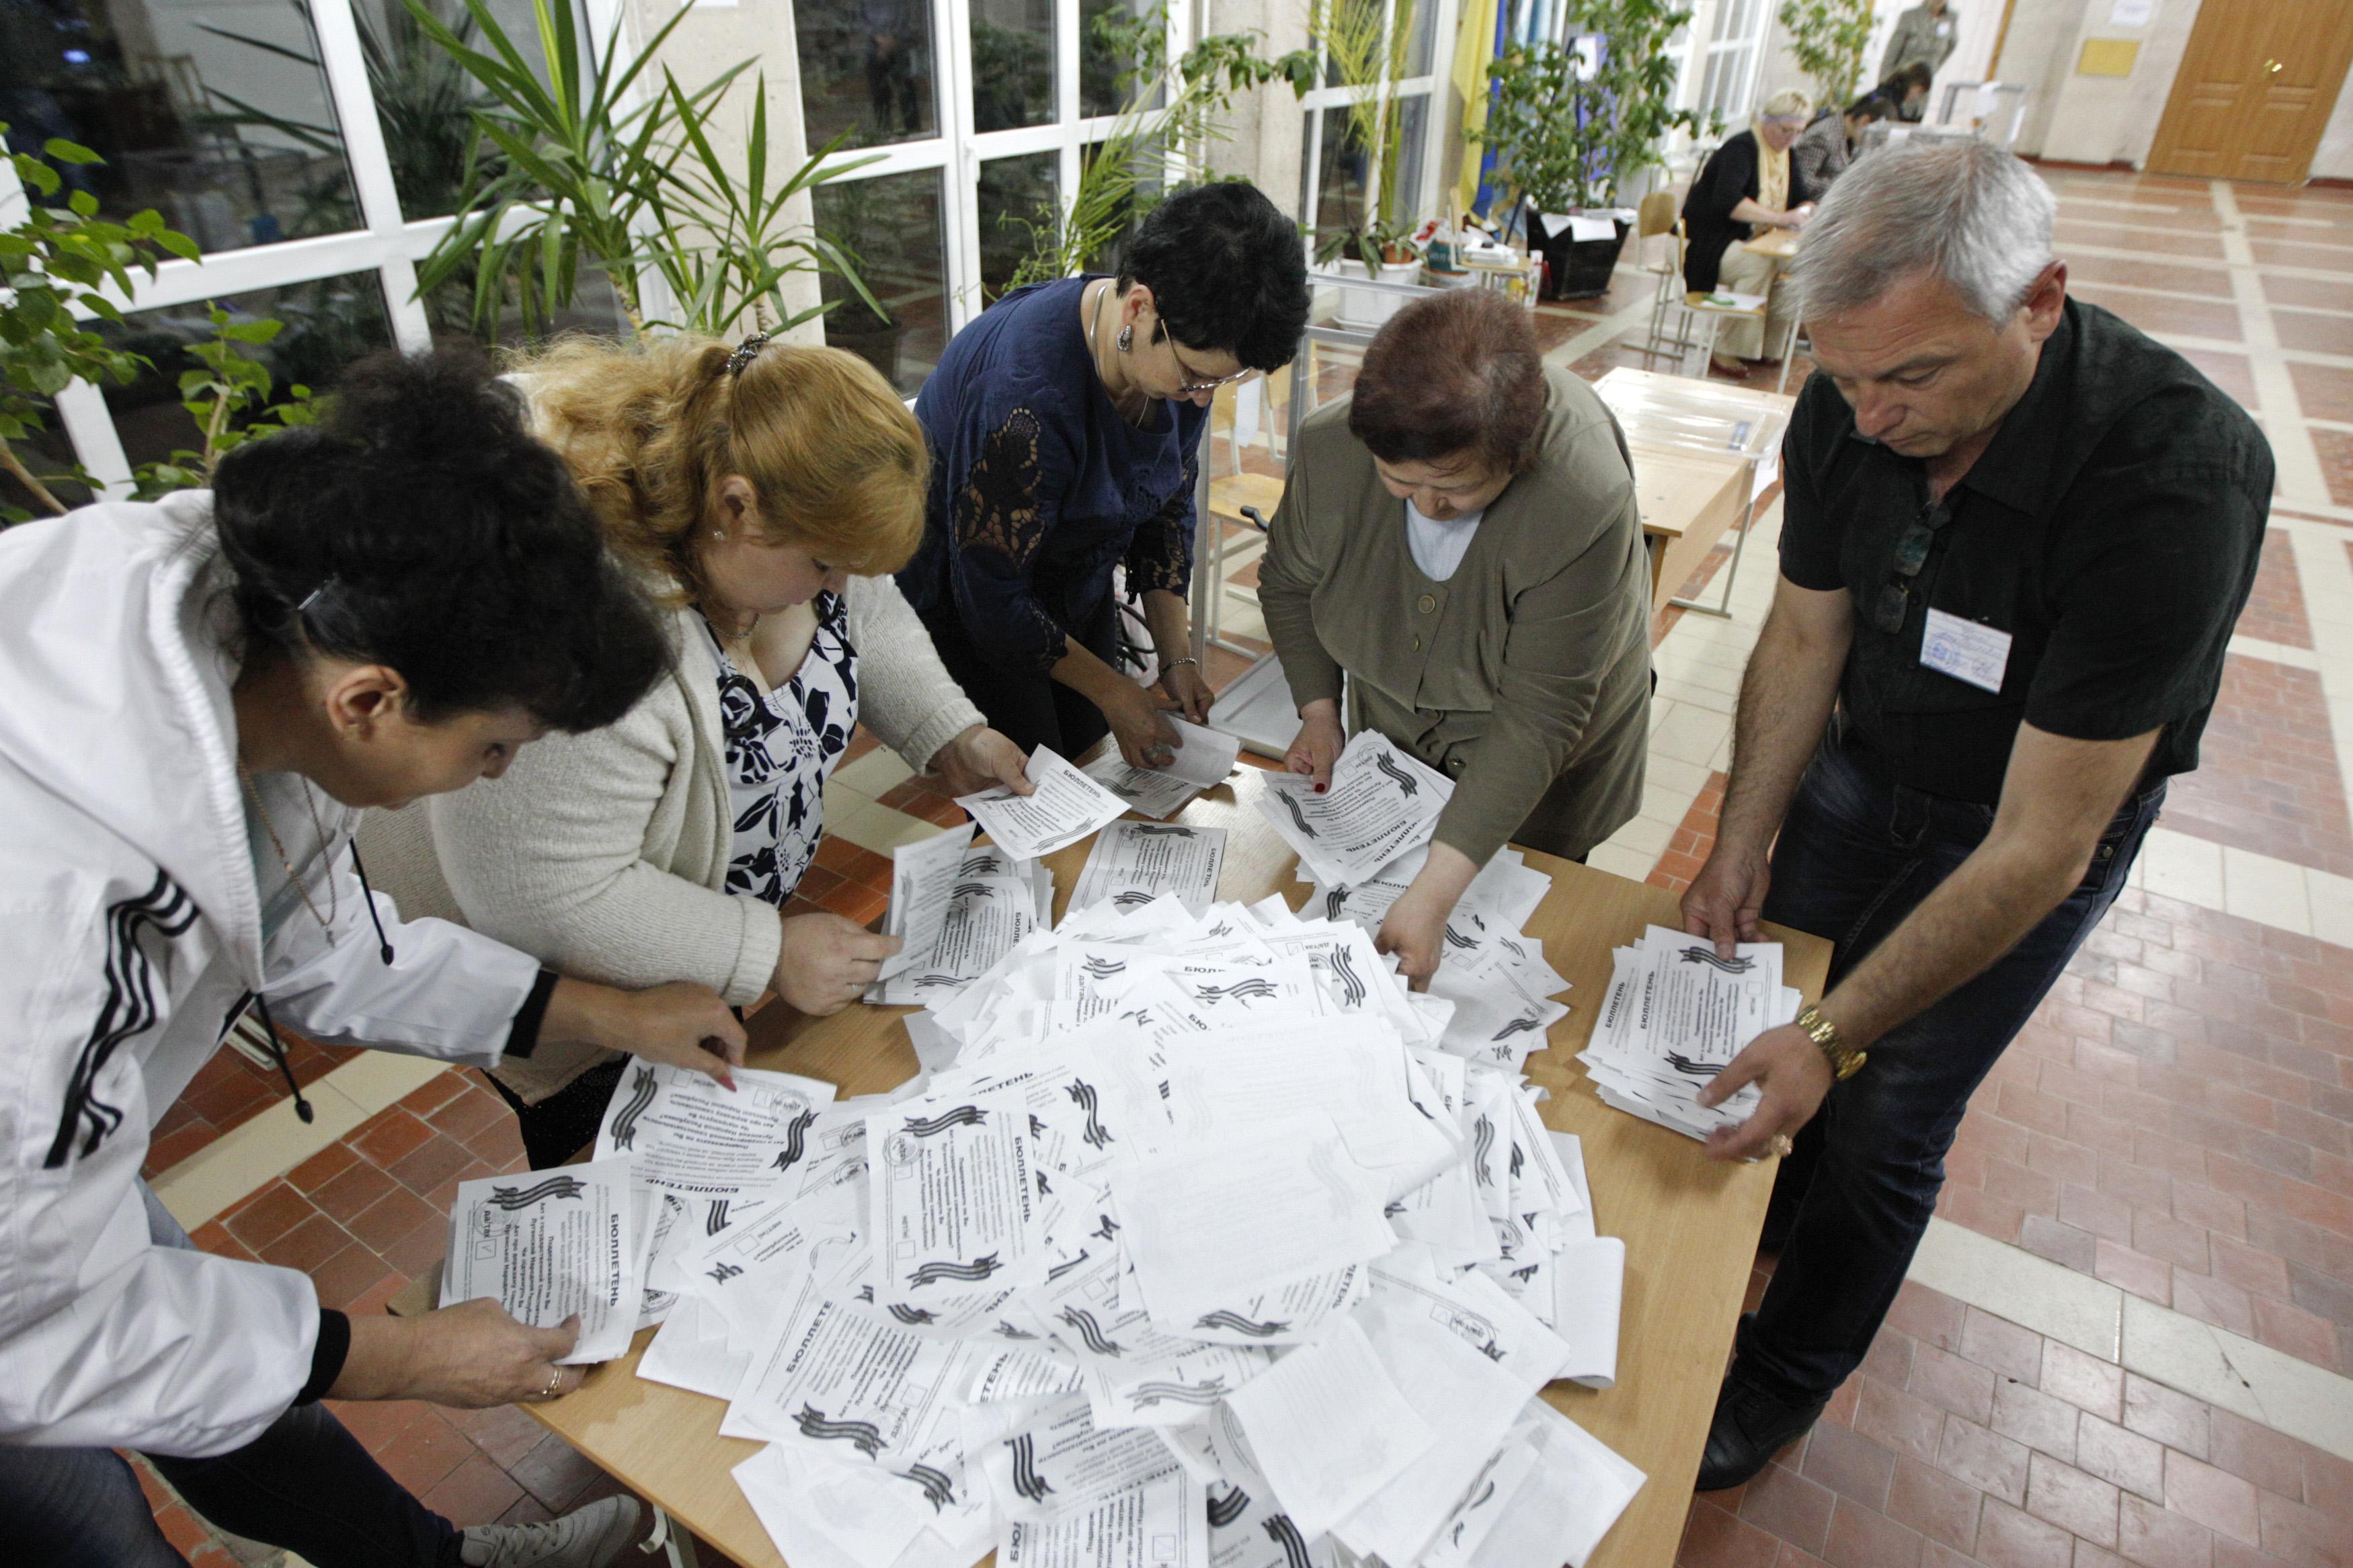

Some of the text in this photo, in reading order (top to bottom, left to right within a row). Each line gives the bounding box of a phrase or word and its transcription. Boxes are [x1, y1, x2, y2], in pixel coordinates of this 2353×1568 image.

[1062, 768, 1102, 799] БЮЛЛЕТЕНЬ
[1345, 819, 1408, 855] БЮЛЛЕТЕНЬ
[1371, 817, 1423, 864] ЮЛЛЕТЕНЬ
[1011, 911, 1021, 948] БЮЛЛЕ
[1605, 981, 1626, 1028] БЮЛЛЕТЕНЬ
[1638, 970, 1656, 1029] БЮЛЛЕТЕНЬ
[644, 1177, 739, 1196] БЮЛЛЕТЕНЬ
[1013, 1136, 1031, 1223] БЮЛЛЕТЕНЬ
[481, 1210, 492, 1238] да/так
[610, 1214, 619, 1307] БЮЛЛЕТЕНЬ
[1330, 1262, 1358, 1311] ЛЕТЕНЬ
[785, 1298, 834, 1374] БЮЛЛЕТЕ
[978, 1350, 1009, 1404] ЕТЕНЬ
